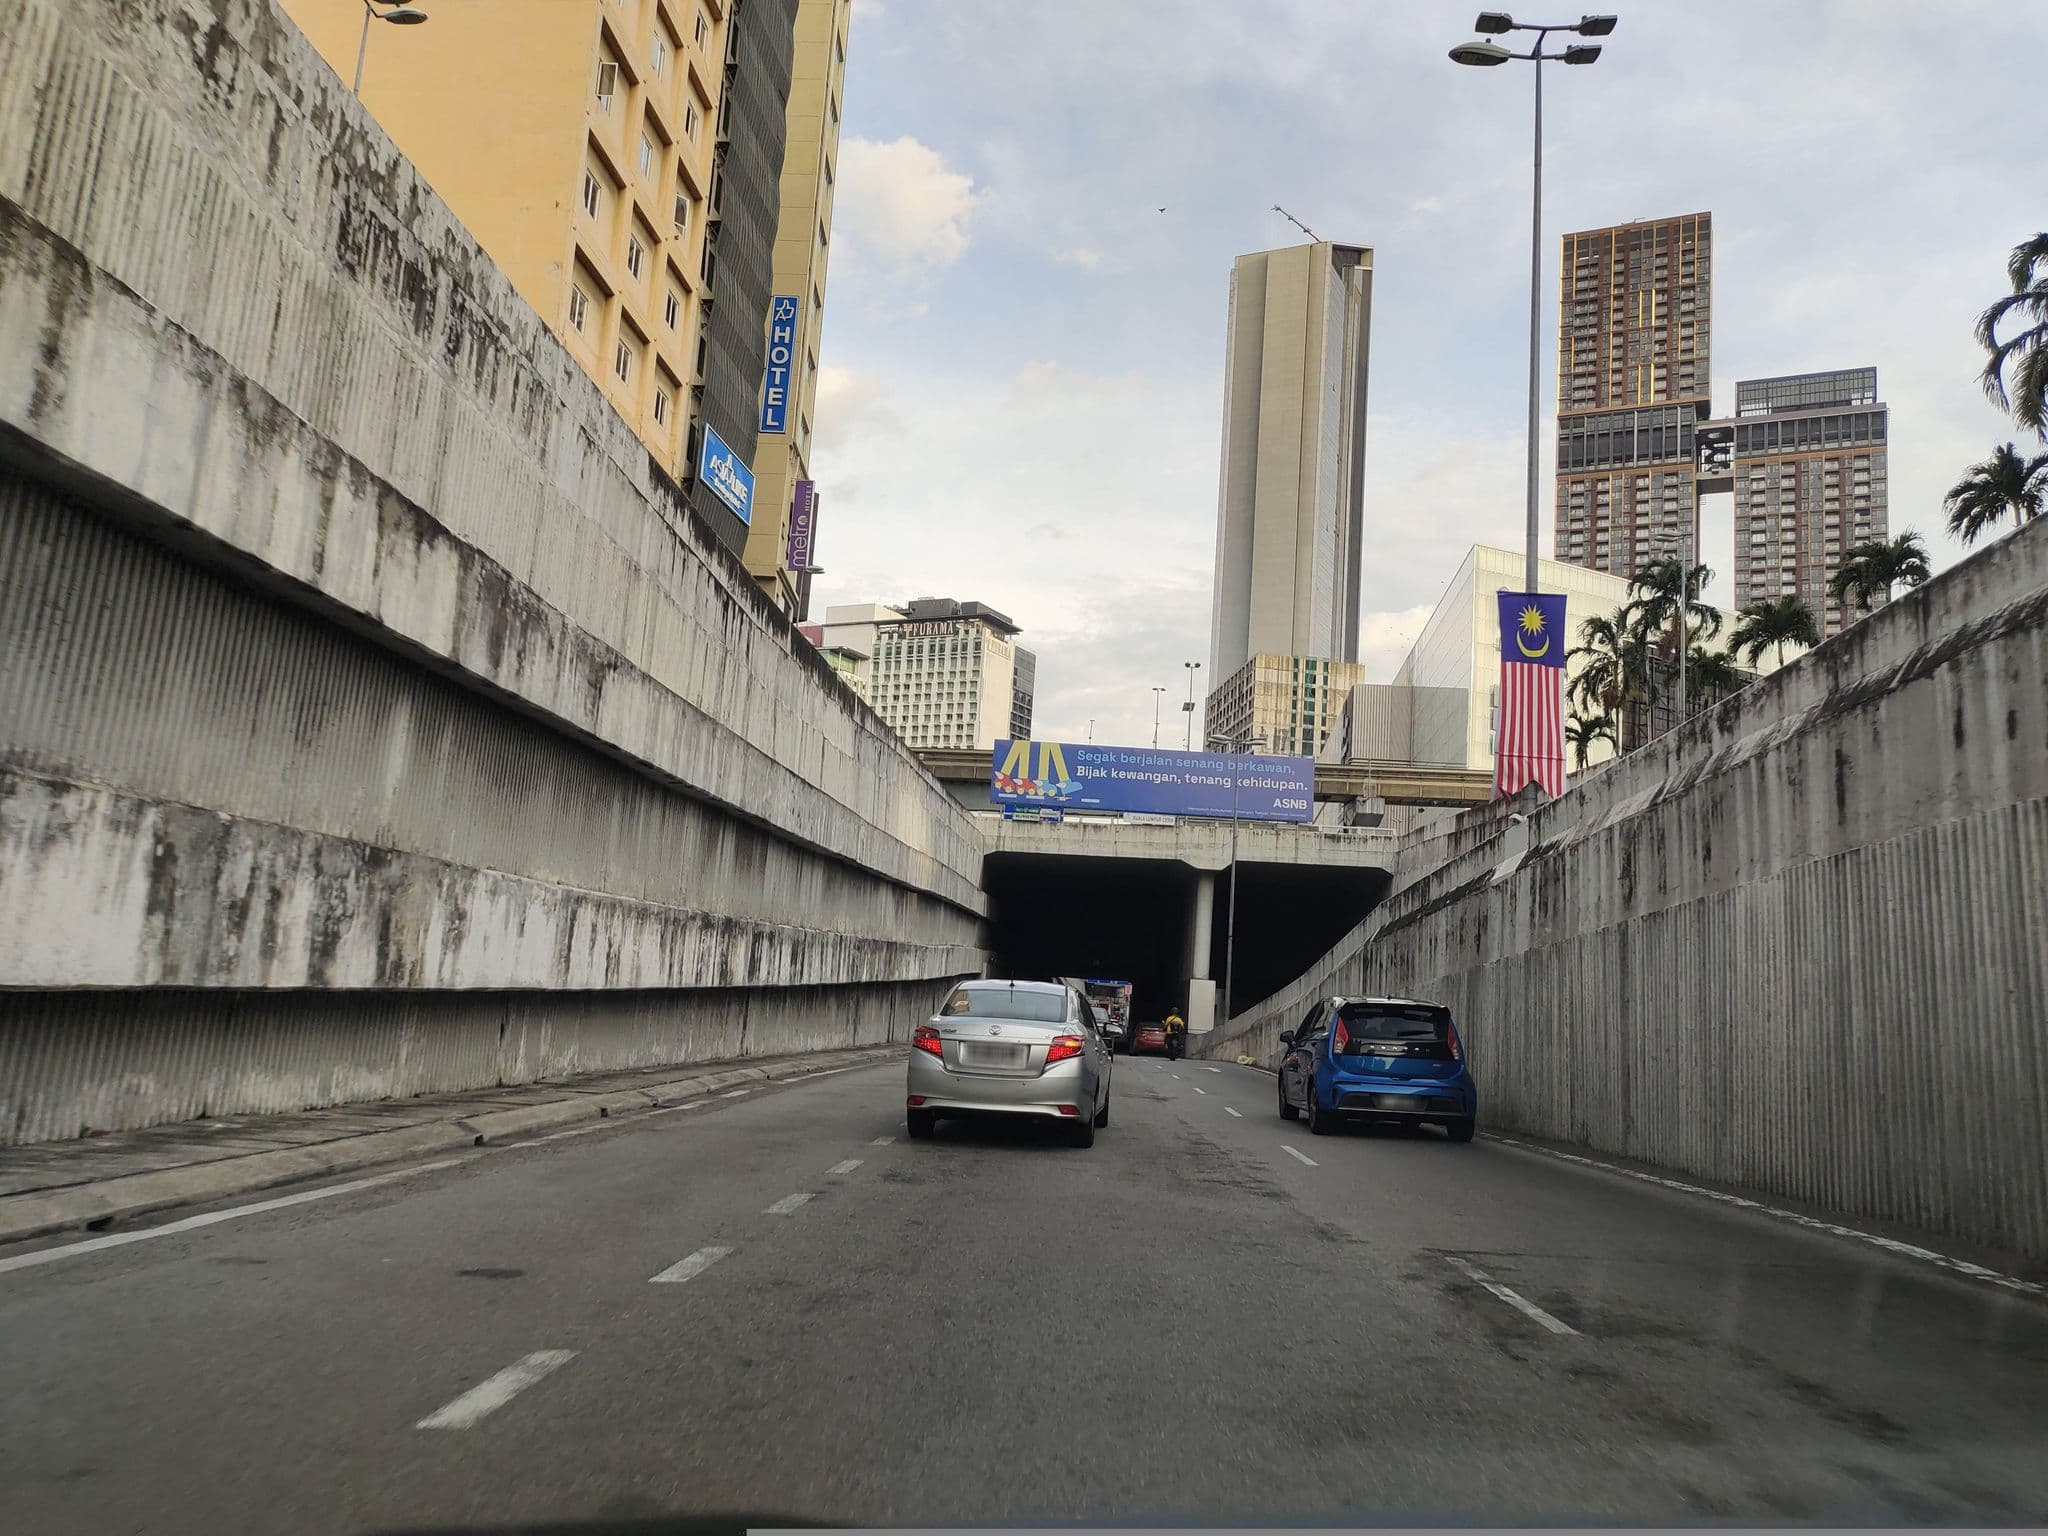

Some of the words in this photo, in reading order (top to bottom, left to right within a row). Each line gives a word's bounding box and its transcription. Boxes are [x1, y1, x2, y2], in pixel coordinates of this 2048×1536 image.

[766, 326, 791, 427] HOTEL
[792, 515, 809, 567] metro
[913, 621, 954, 637] FURAMA
[1077, 750, 1117, 763] Segak
[1120, 752, 1173, 767] berjalan
[1176, 757, 1224, 772] senang
[1227, 760, 1296, 776] berkawan,
[1076, 766, 1108, 780] Bijak
[1111, 768, 1182, 785] kewangan,
[1184, 773, 1232, 788] tenang
[1273, 798, 1308, 810] ASNB
